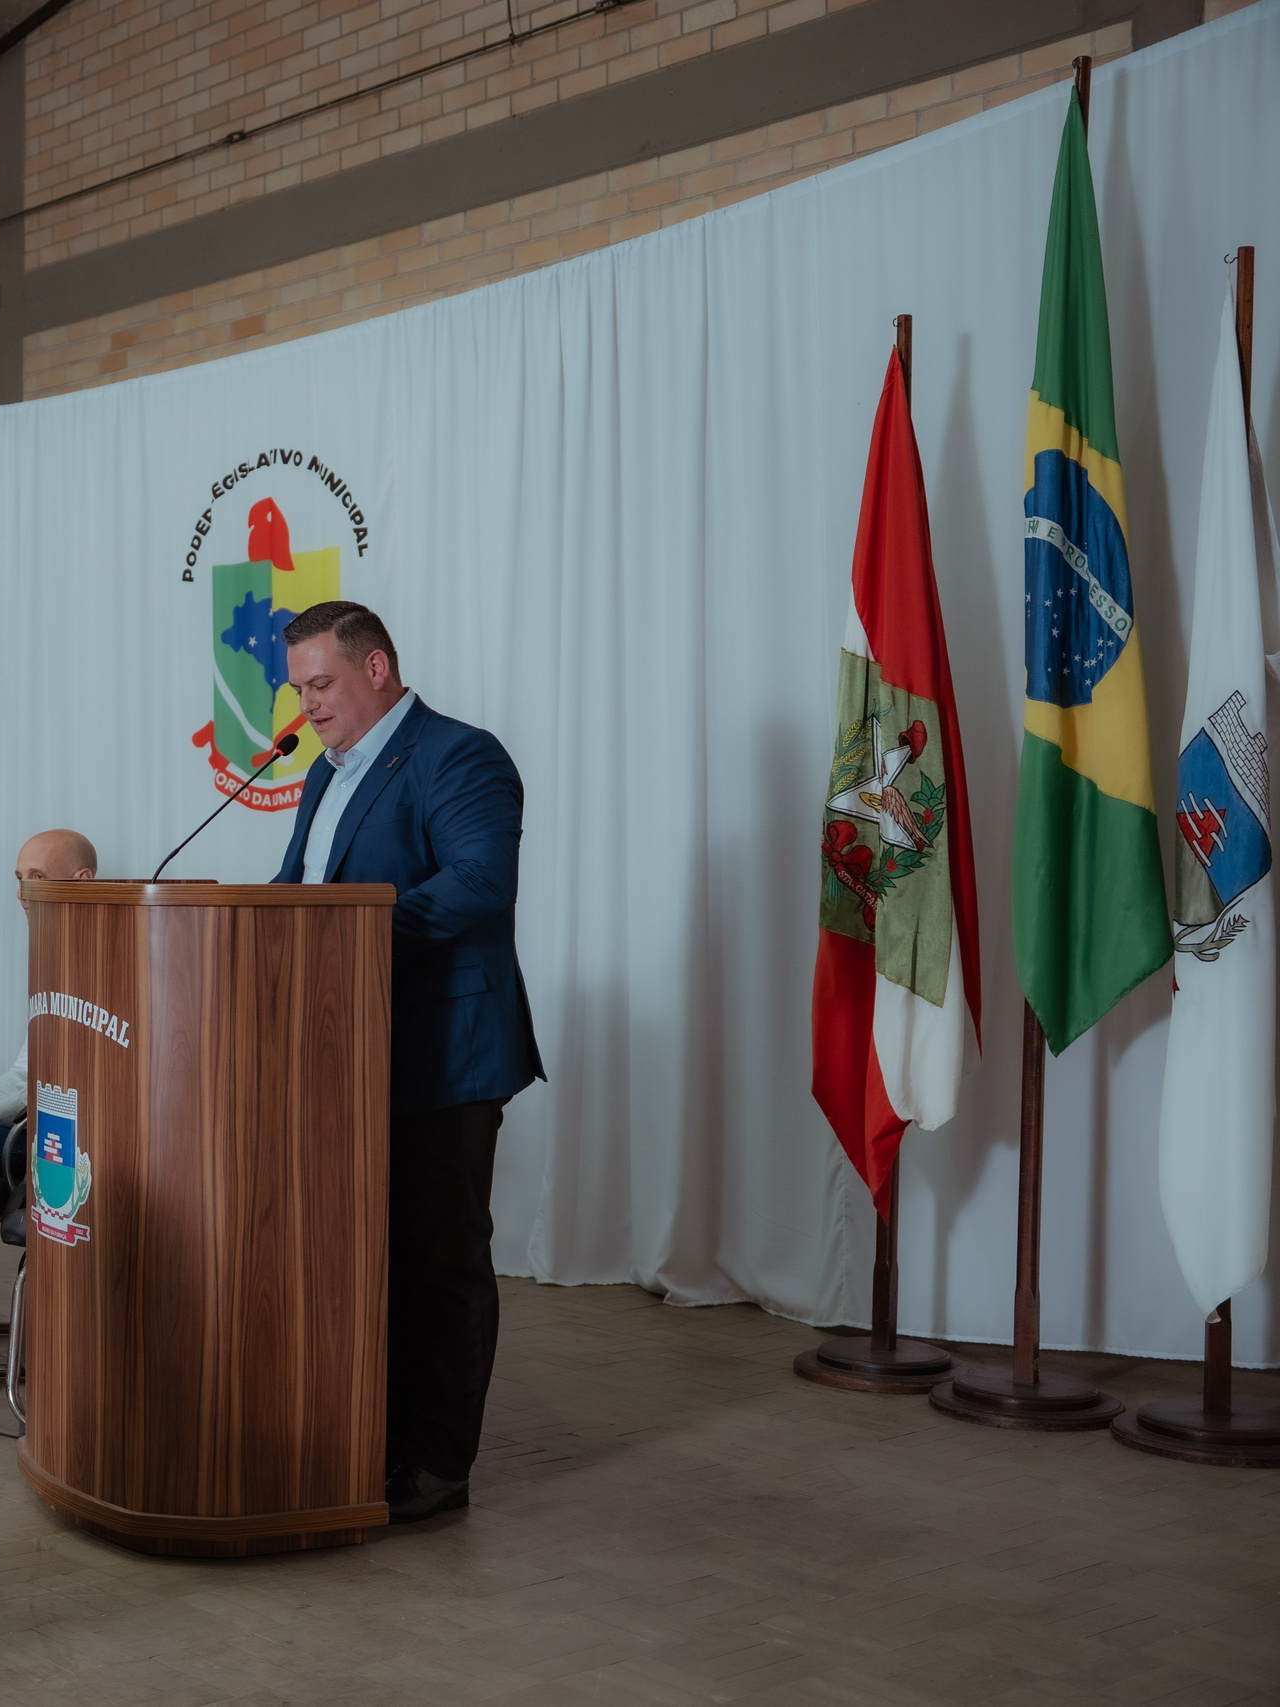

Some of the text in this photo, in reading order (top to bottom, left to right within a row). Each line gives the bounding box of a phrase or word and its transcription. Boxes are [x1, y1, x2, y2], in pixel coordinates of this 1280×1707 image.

[211, 448, 303, 500] EGISLATIVO
[307, 455, 368, 557] MUNICIPAL
[251, 791, 272, 807] DA
[50, 991, 130, 1048] MUNICIPAL
